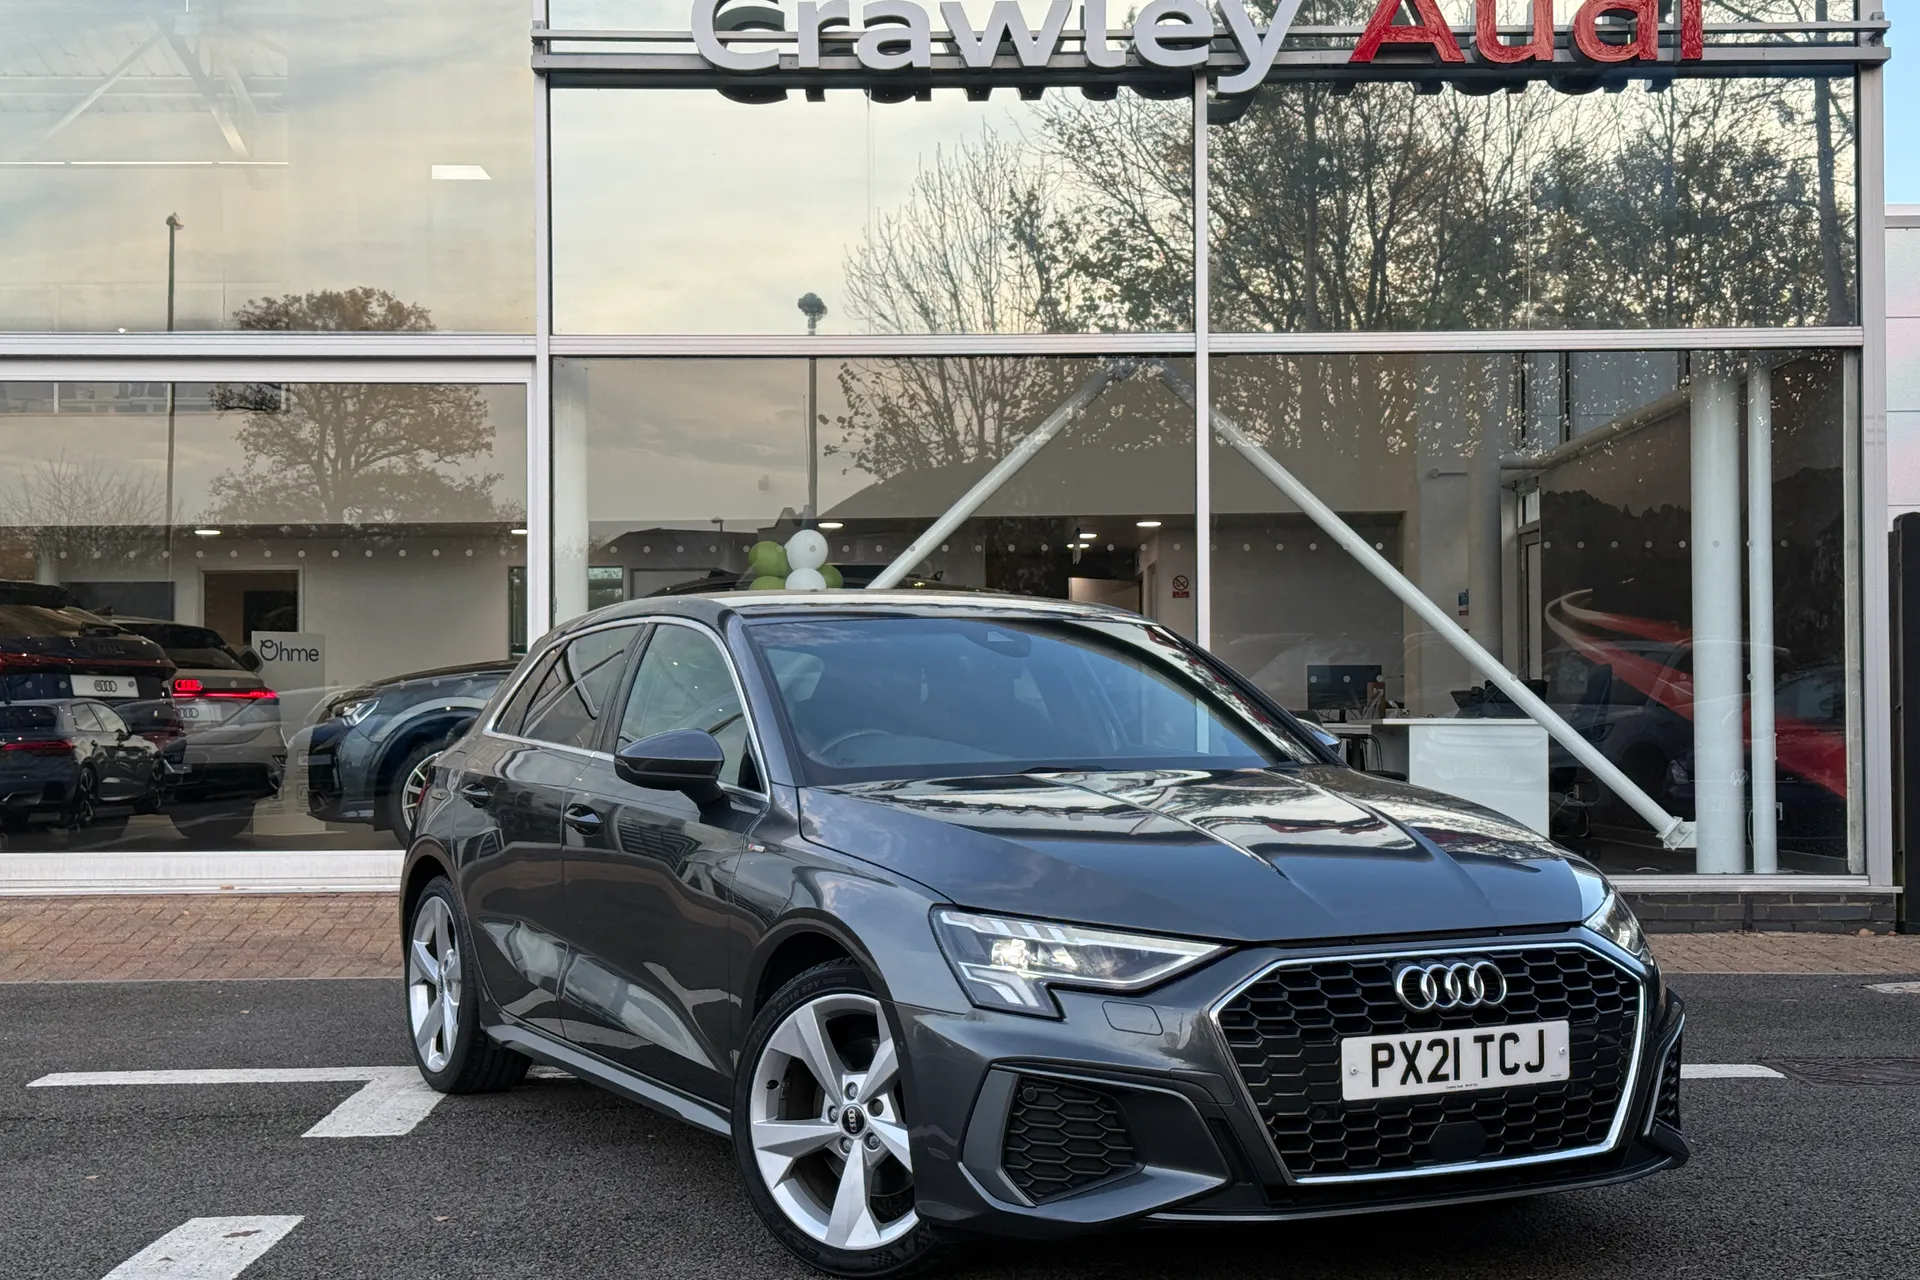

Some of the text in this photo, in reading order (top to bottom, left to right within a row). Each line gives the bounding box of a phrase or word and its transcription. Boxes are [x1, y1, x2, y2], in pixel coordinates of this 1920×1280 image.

[691, 0, 1703, 94] Crawley Audi
[260, 639, 320, 662] Ohme
[1371, 1029, 1545, 1088] PX21 TCJ
